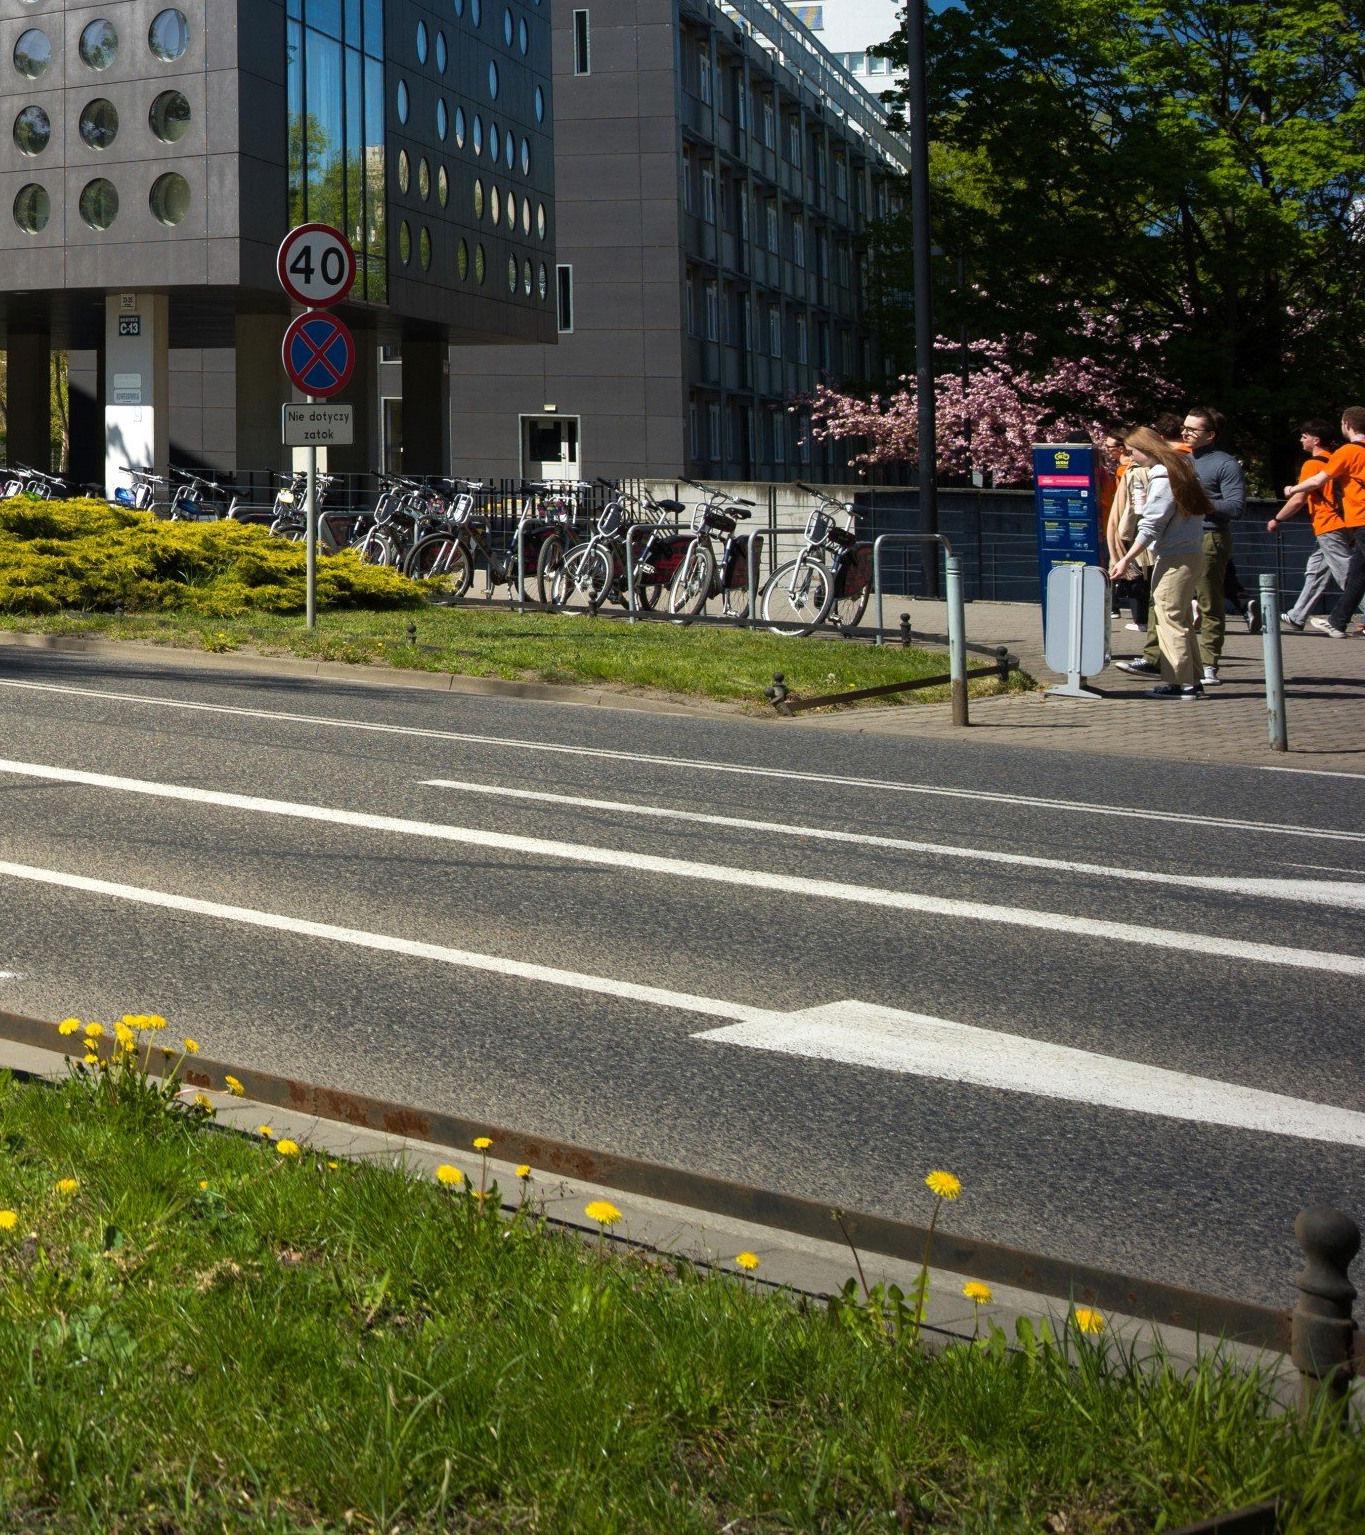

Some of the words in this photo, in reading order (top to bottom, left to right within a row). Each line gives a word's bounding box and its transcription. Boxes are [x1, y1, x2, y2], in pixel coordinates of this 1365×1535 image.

[289, 245, 345, 286] 40
[120, 322, 139, 334] C-13
[289, 411, 305, 422] Nie
[309, 411, 349, 424] dotyczy
[304, 429, 334, 440] zatok
